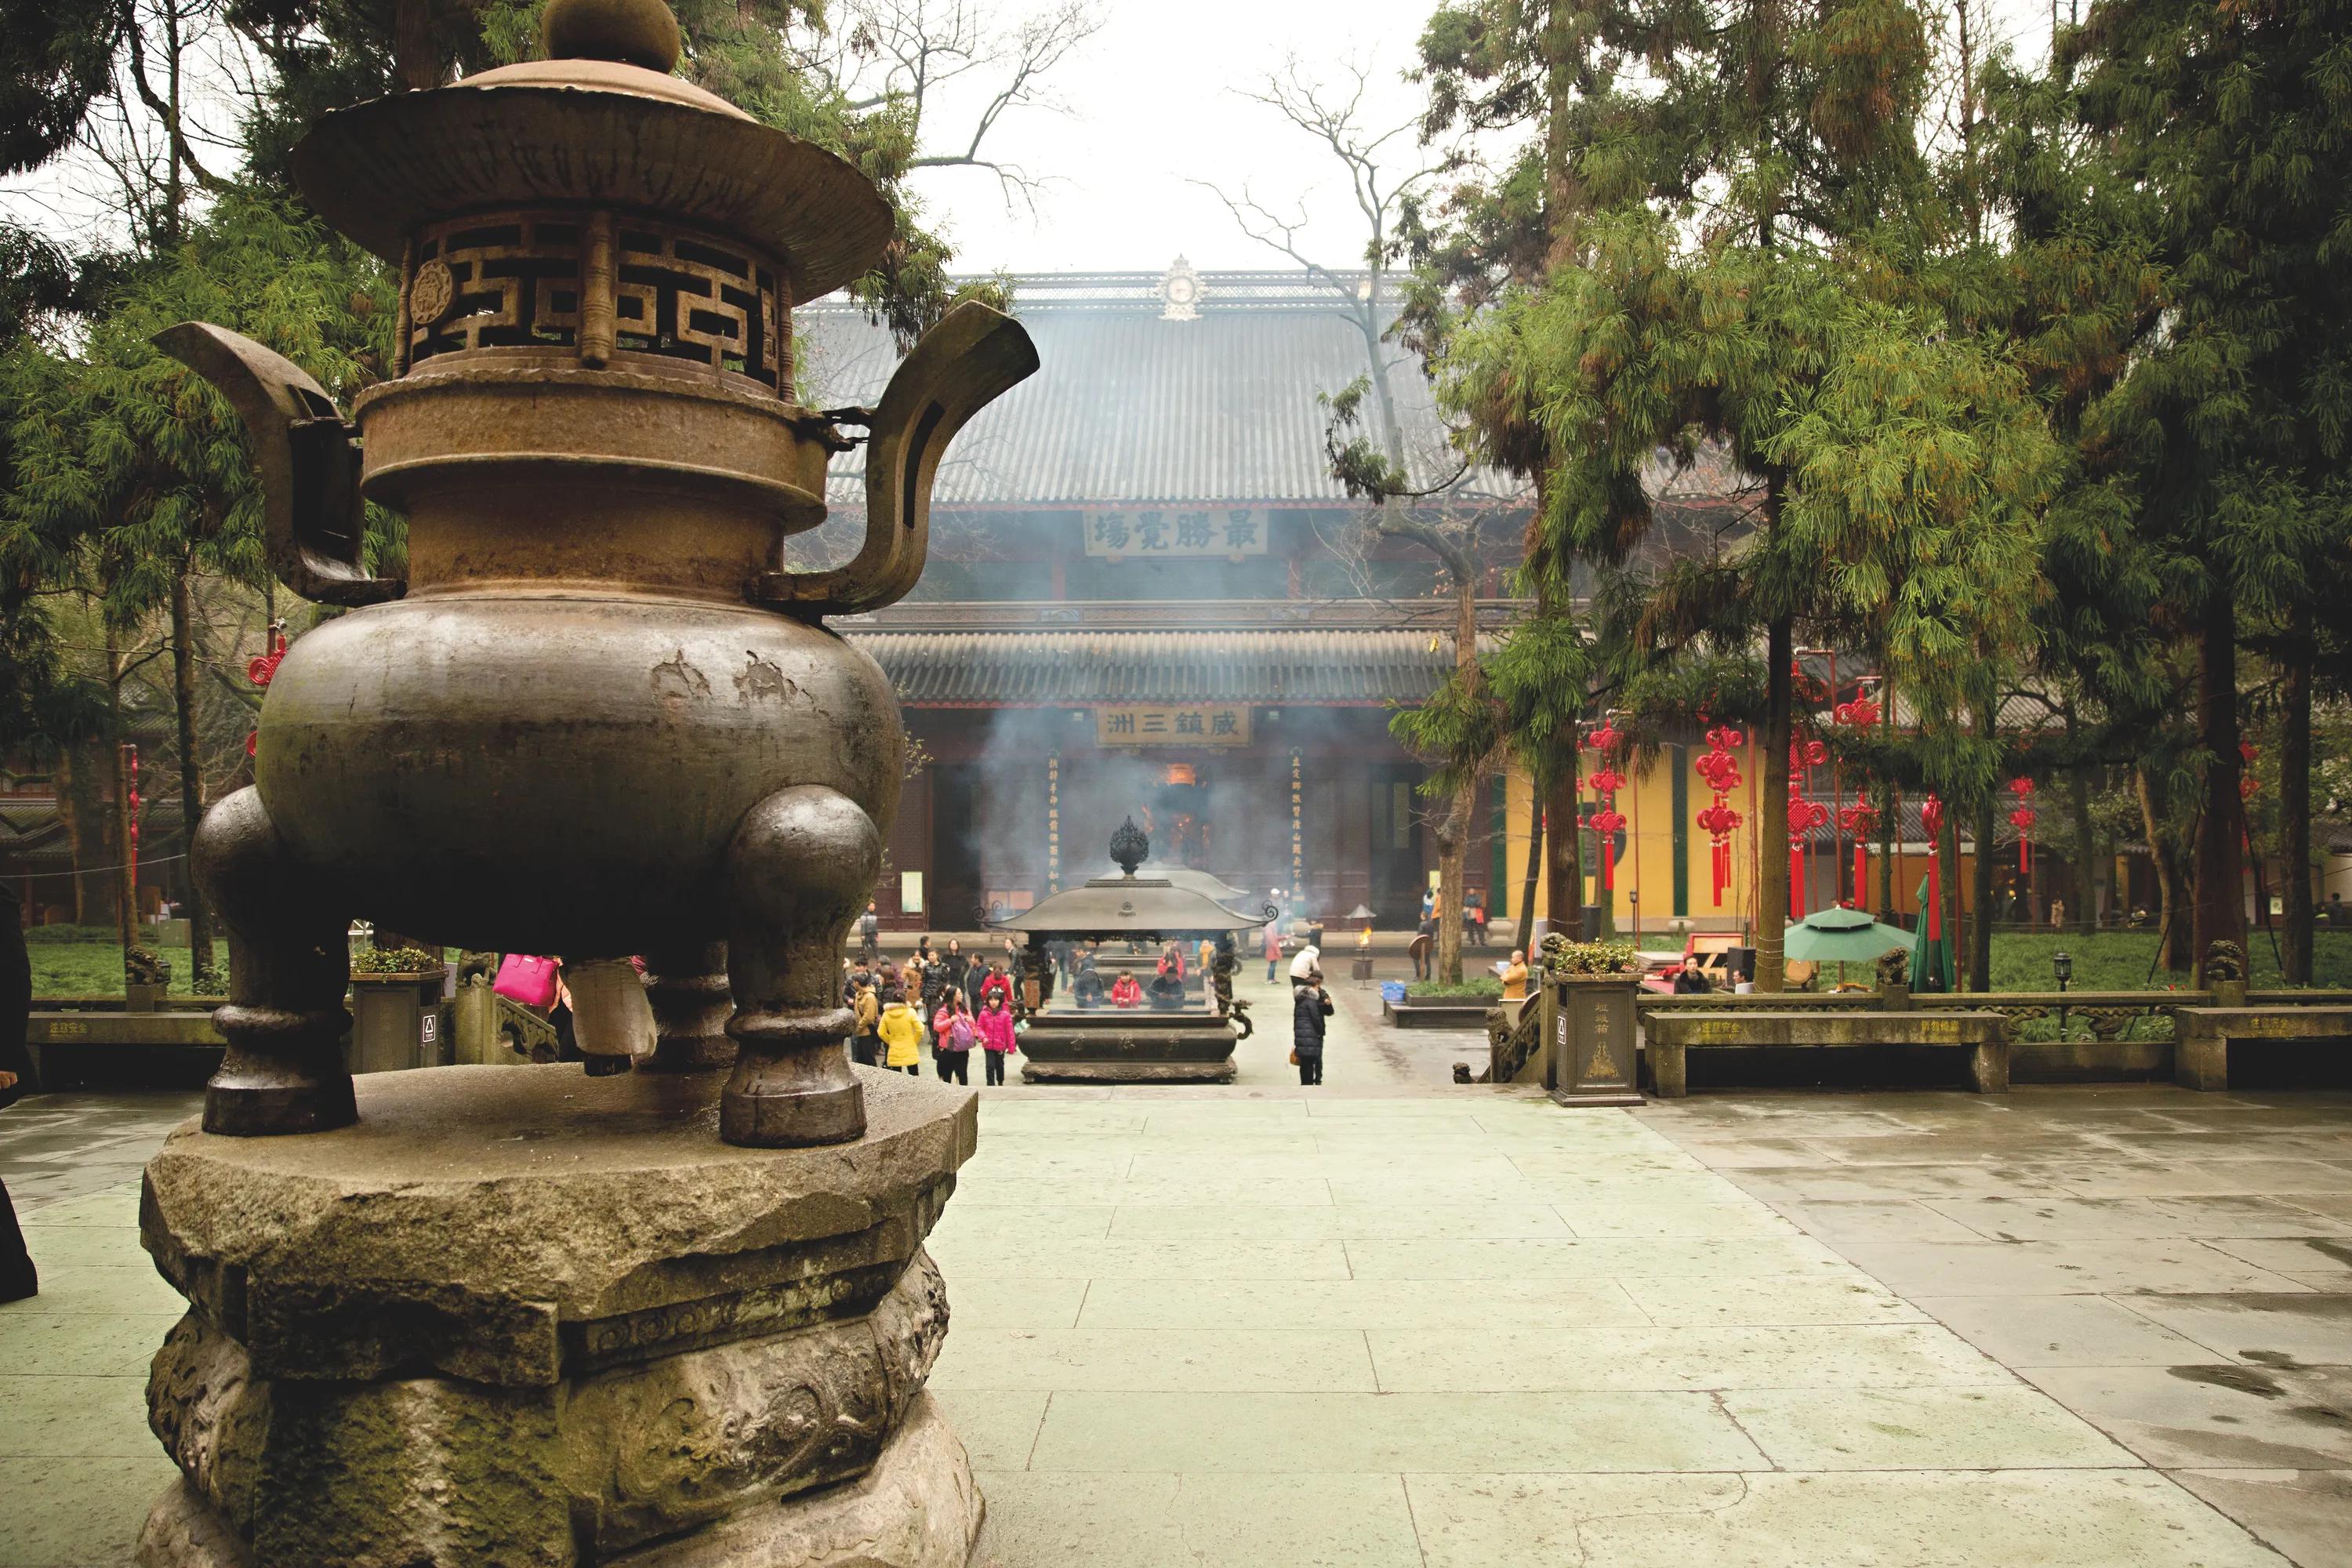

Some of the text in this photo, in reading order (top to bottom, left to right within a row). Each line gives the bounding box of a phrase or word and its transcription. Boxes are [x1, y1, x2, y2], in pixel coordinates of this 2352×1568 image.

[1107, 710, 1240, 735] 威鎮三洲
[1595, 1003, 1609, 1035] 垃圾箱
